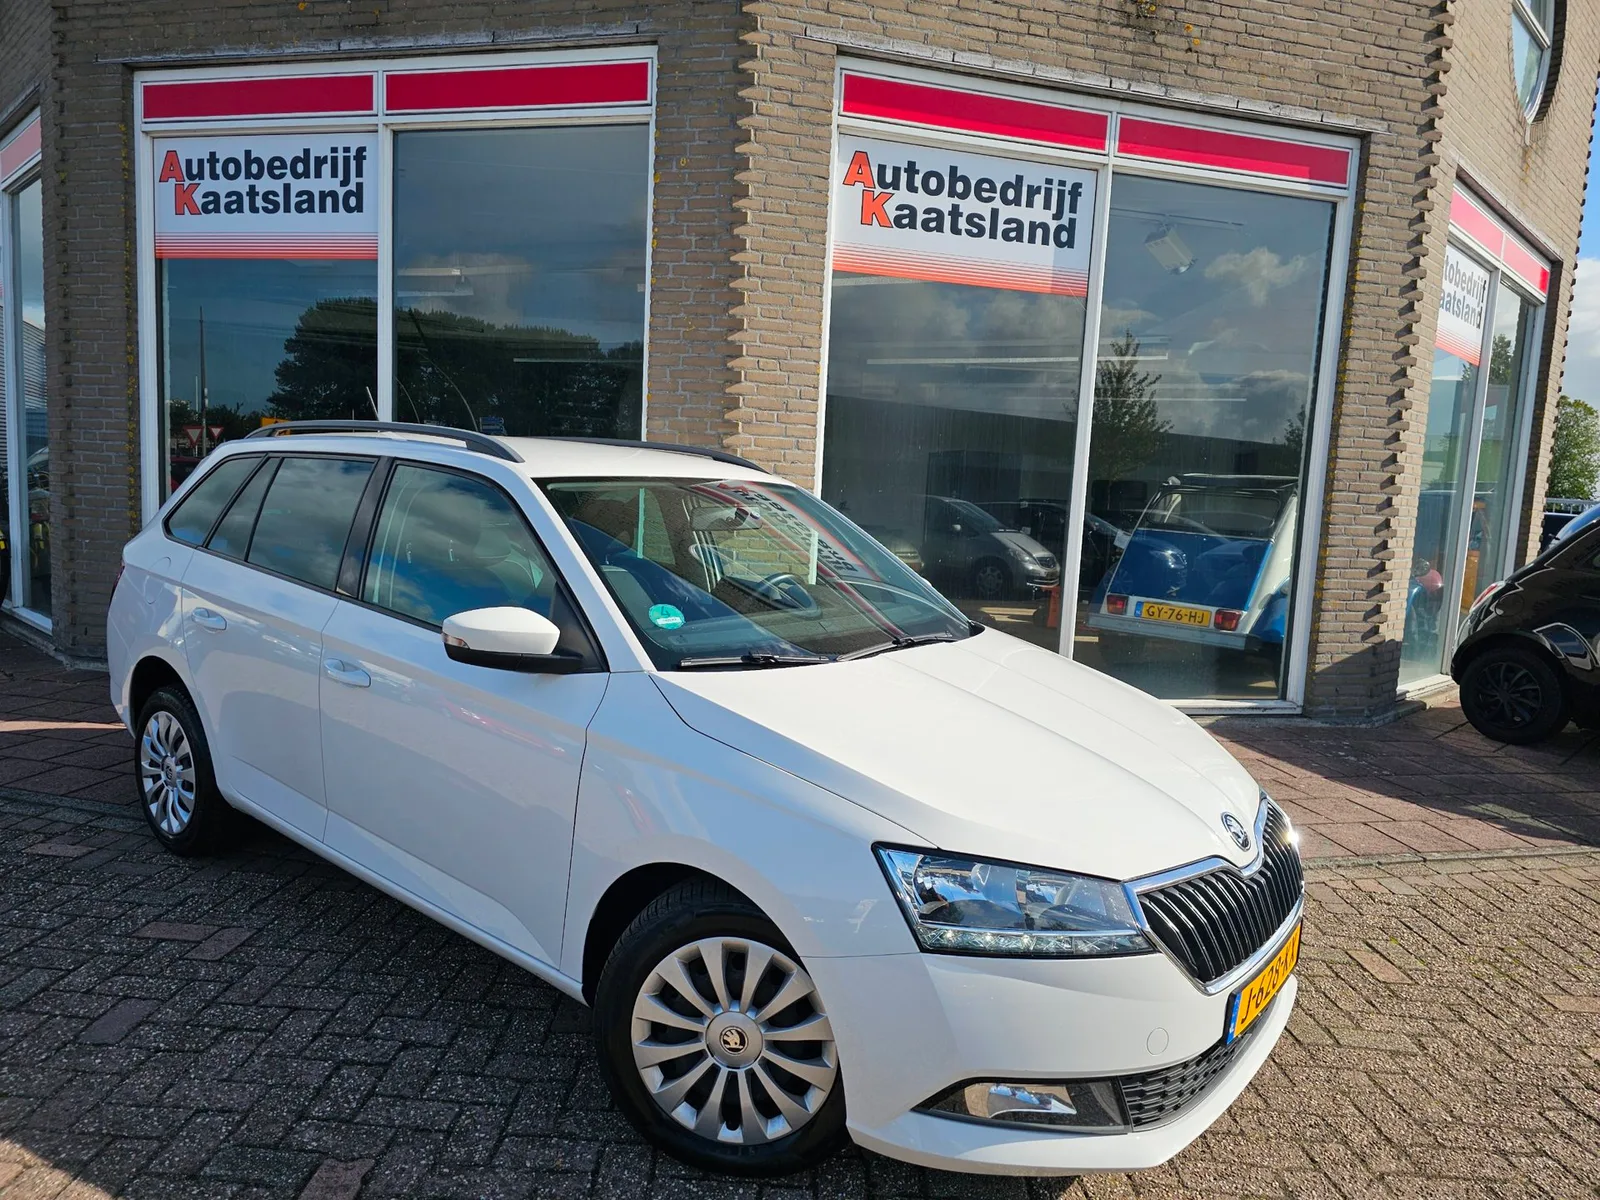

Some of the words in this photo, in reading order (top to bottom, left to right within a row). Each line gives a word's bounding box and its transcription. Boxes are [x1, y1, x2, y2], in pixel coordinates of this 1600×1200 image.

[159, 146, 367, 188] Autobedrijf
[843, 151, 1083, 221] Autobedrijf
[175, 182, 364, 216] Kaatsland
[861, 189, 1077, 249] Kaatsland
[1444, 255, 1487, 308] tobedrijf
[1440, 288, 1483, 330] aatsland
[1146, 605, 1205, 624] GY-76-HJ
